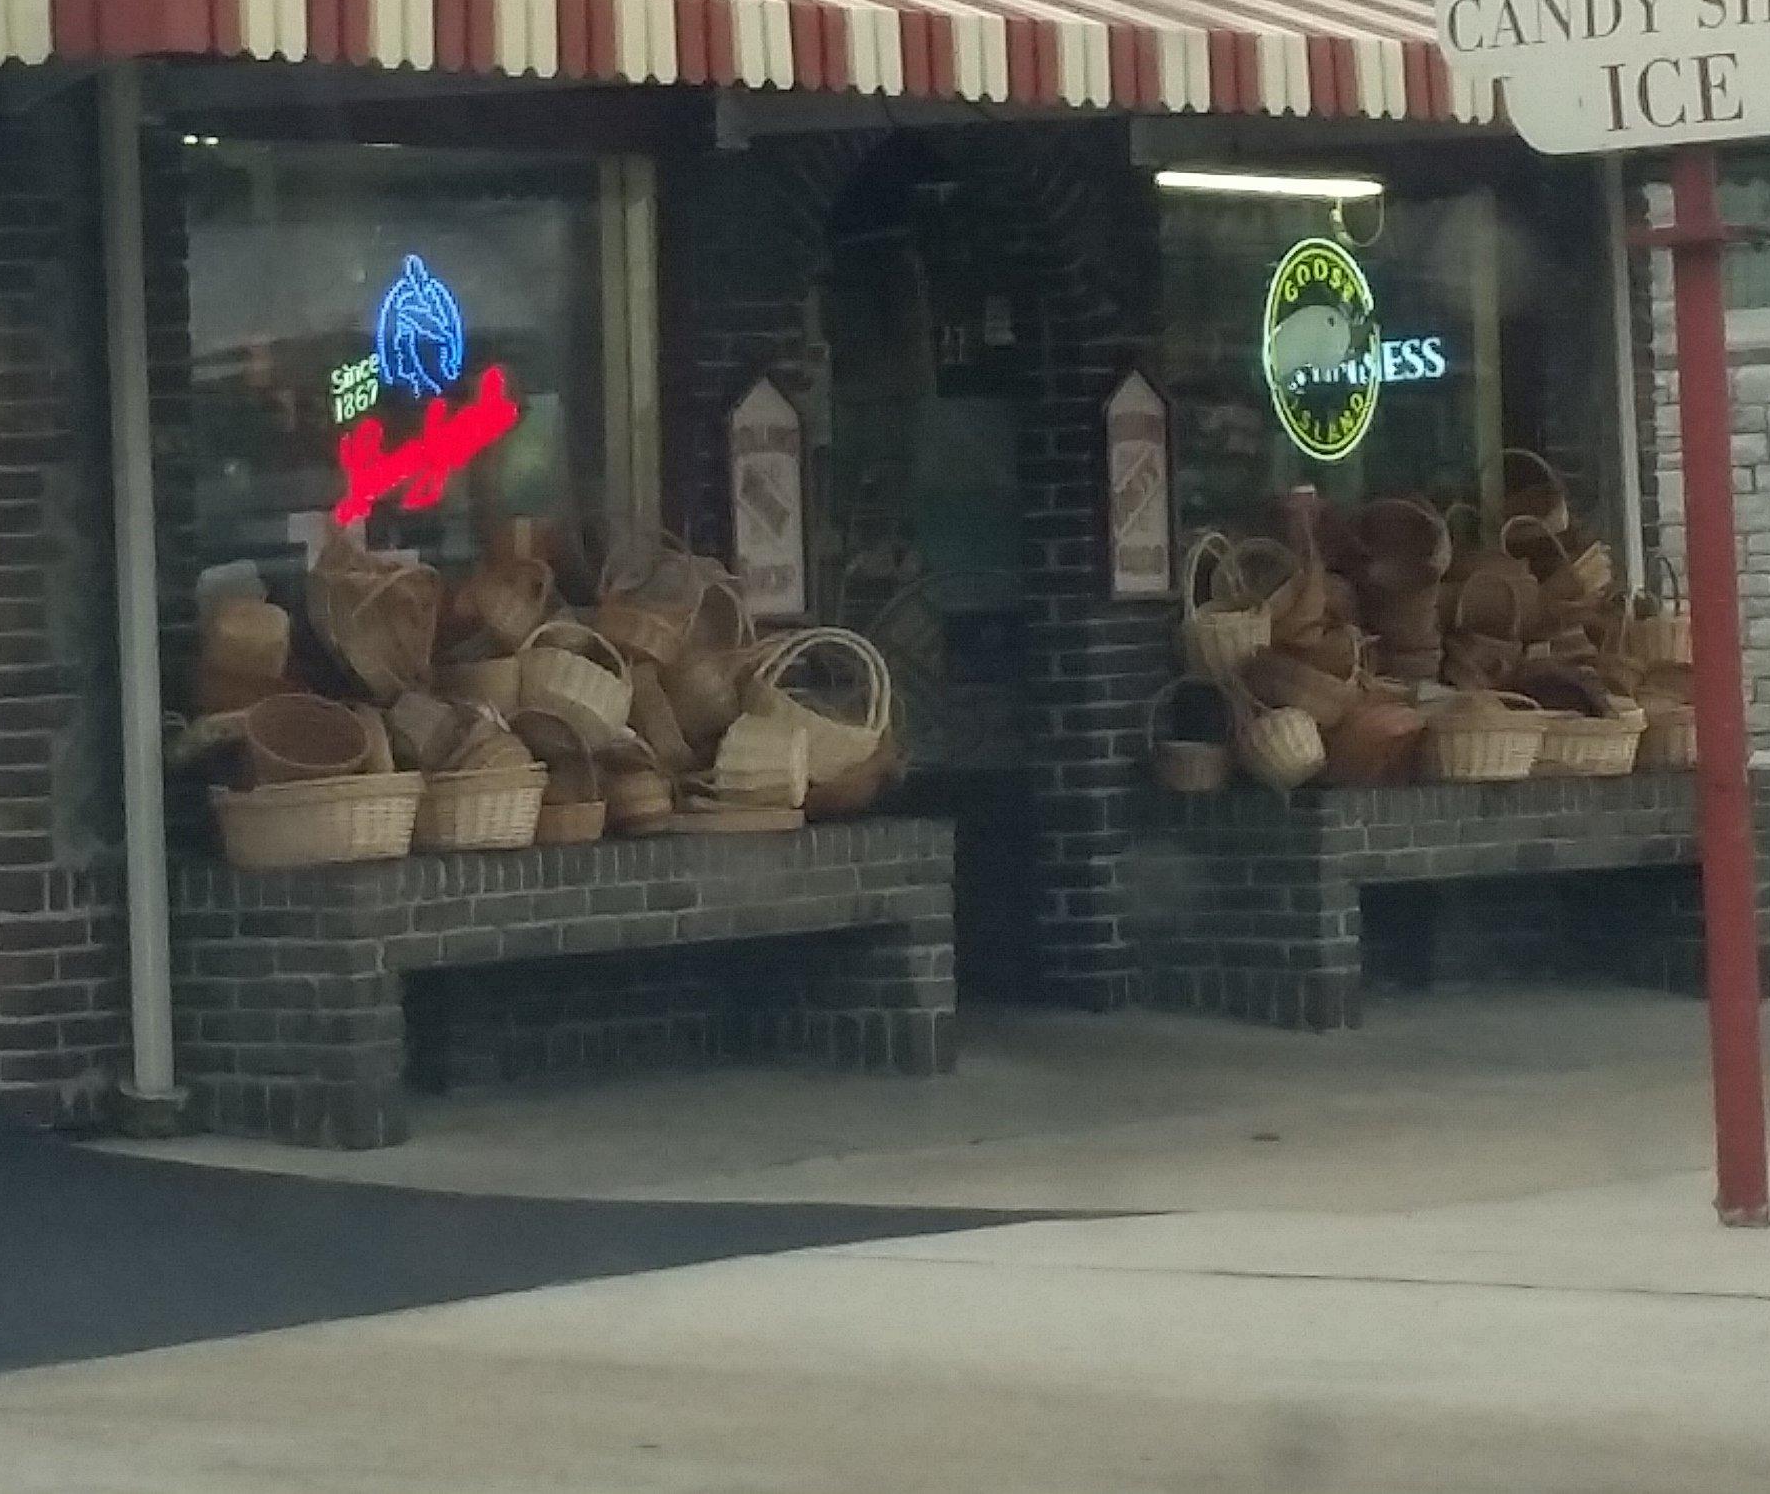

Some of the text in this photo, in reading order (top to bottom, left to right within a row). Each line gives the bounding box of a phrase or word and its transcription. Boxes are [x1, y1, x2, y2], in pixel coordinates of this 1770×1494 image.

[1601, 52, 1744, 133] ICE
[330, 352, 379, 396] Since
[334, 378, 379, 424] 1867
[1293, 392, 1366, 441] SLAND
